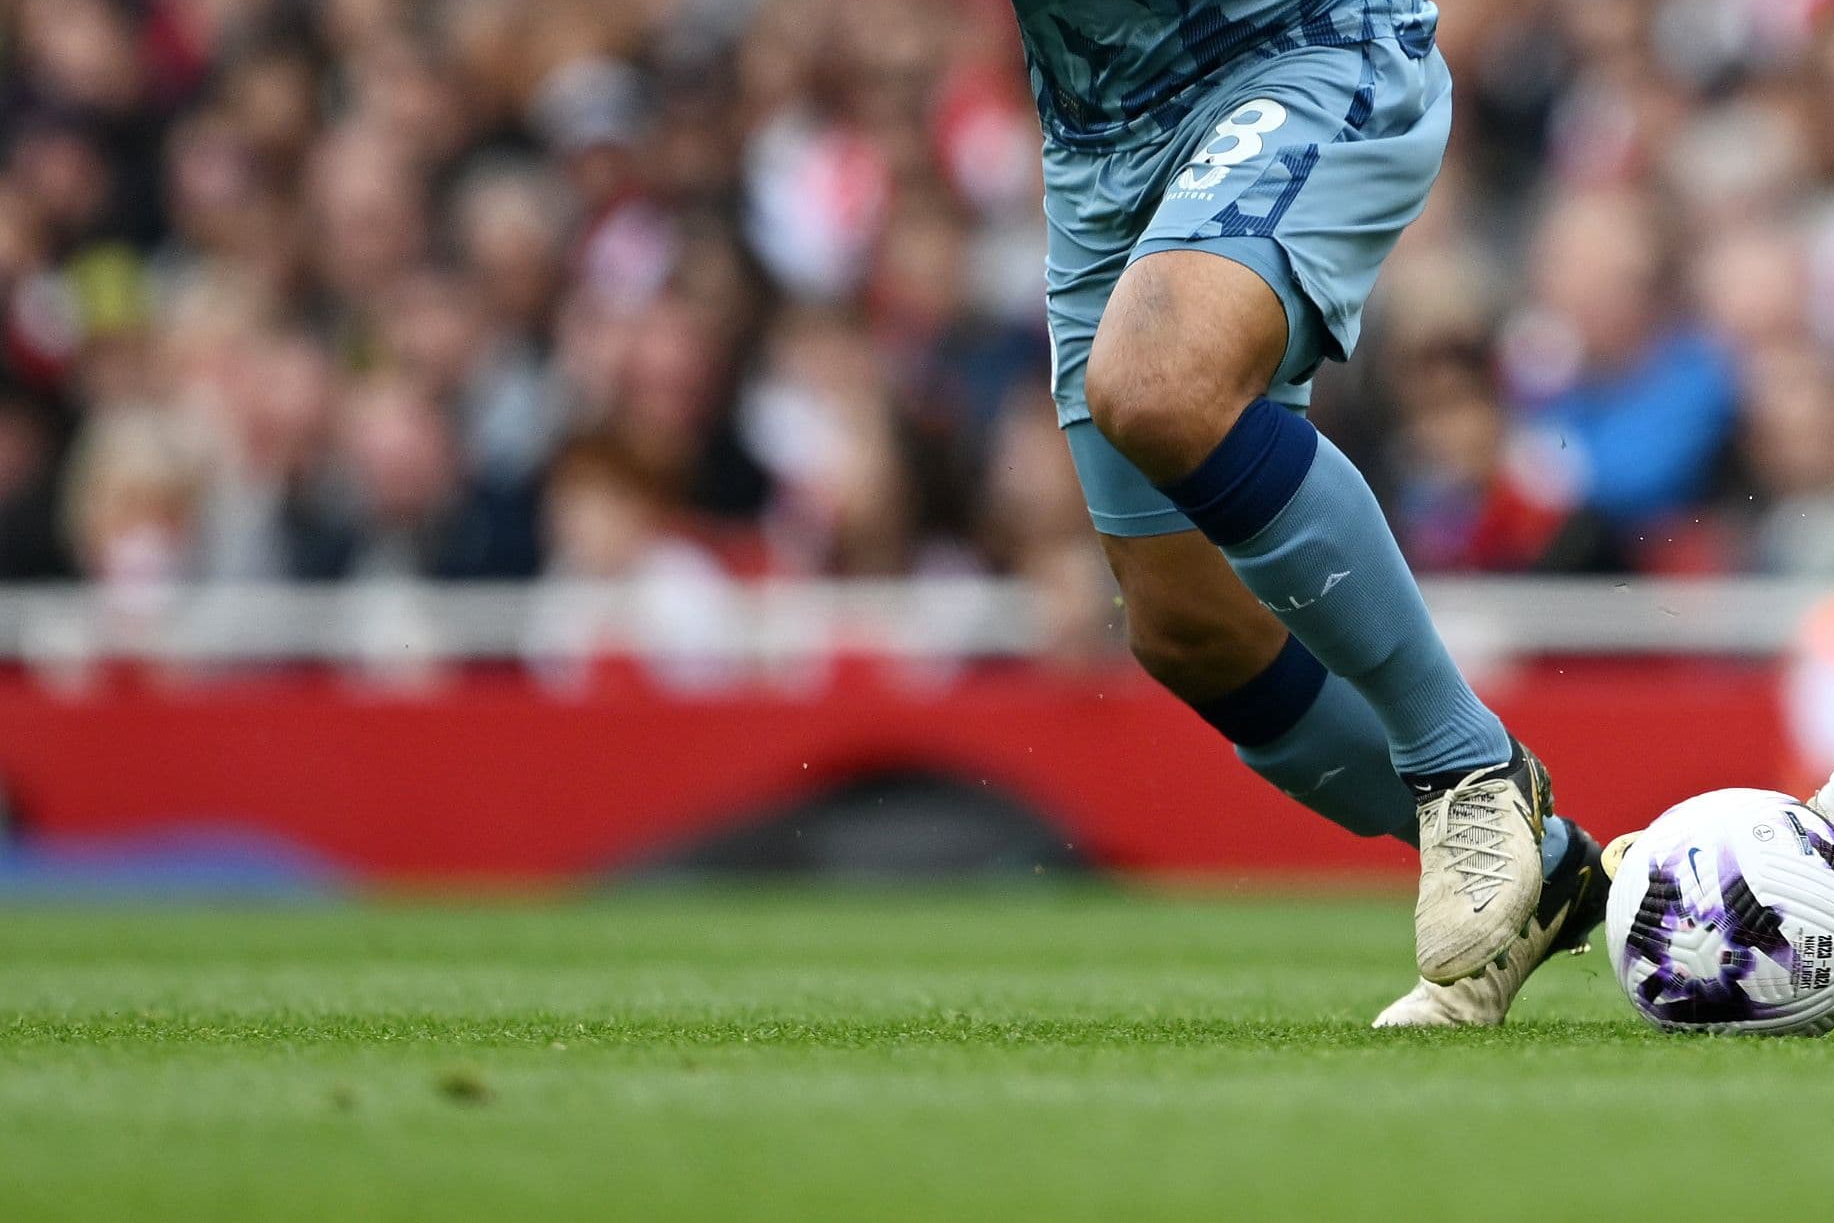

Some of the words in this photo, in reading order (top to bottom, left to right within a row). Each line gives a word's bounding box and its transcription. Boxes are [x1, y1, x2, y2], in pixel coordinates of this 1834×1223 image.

[1190, 98, 1288, 166] 8
[1803, 935, 1815, 960] NIKE
[1800, 959, 1814, 990] FLIGHT
